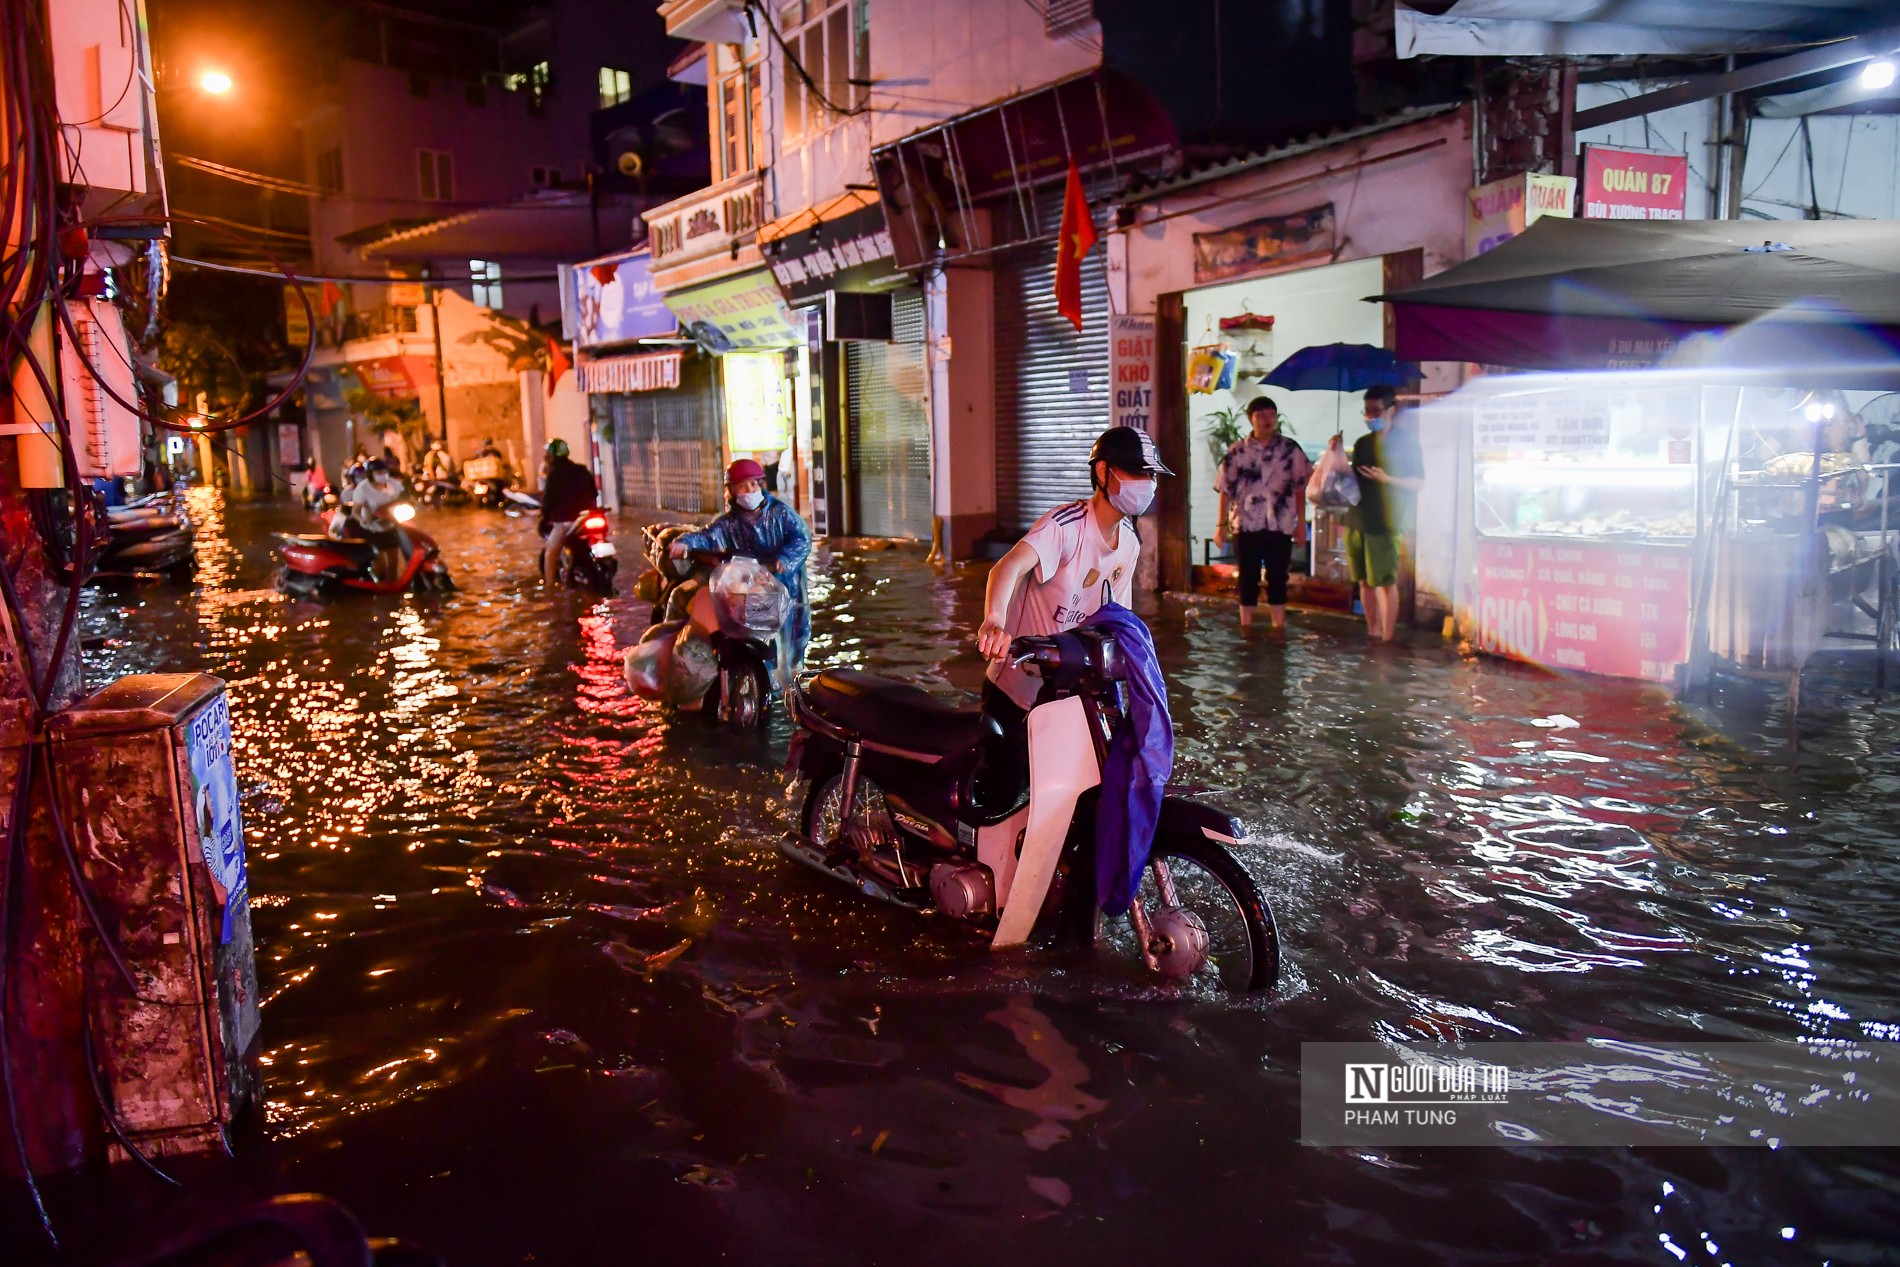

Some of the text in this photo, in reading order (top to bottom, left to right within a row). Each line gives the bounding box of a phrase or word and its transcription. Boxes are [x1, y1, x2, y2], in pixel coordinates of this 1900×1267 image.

[1602, 166, 1673, 195] QUÁN 87
[1531, 182, 1567, 210] QUÁN
[1587, 200, 1607, 218] BÙI
[1117, 335, 1154, 360] GIẶT
[1118, 360, 1150, 383] KHÔ
[1116, 385, 1152, 409] GIẶT
[195, 697, 228, 748] POCARI
